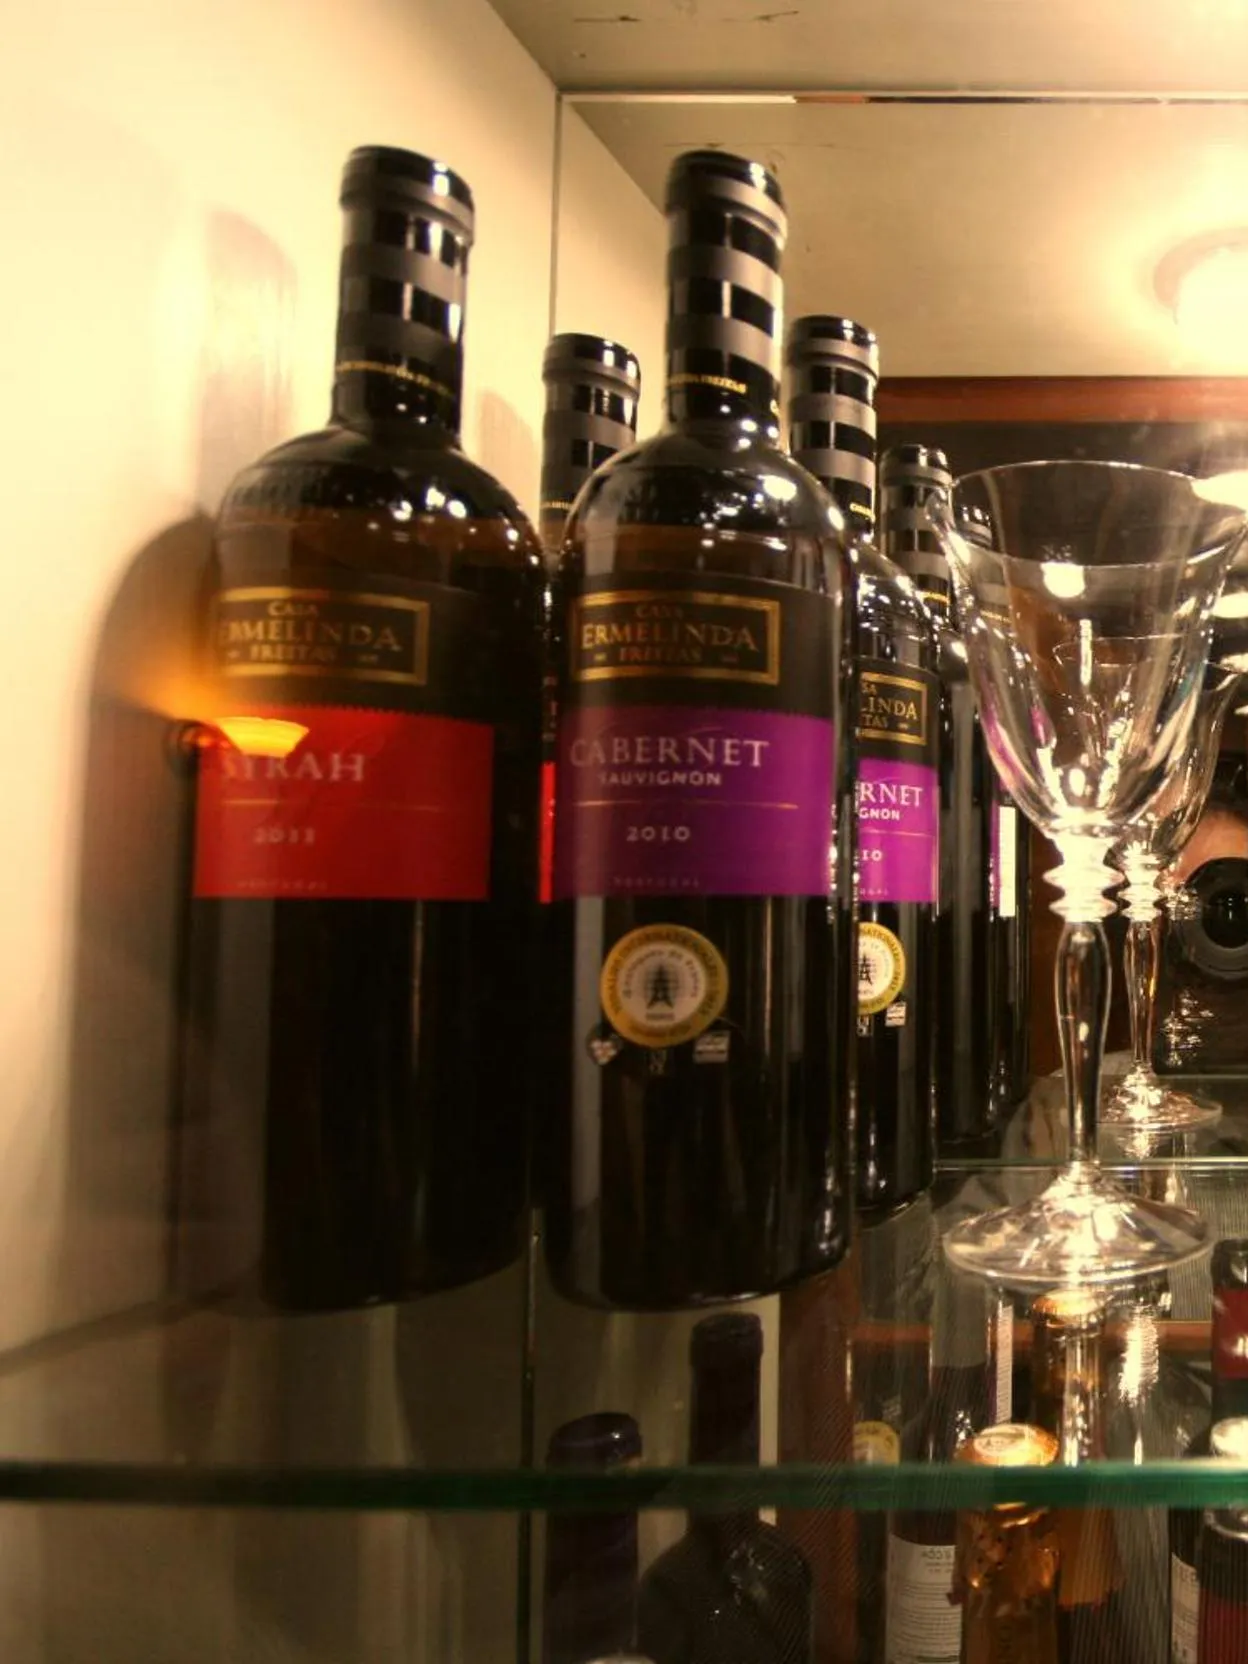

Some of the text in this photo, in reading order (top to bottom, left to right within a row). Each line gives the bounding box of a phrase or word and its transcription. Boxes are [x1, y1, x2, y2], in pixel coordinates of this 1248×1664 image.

[580, 622, 760, 653] ERMELINDA
[569, 736, 770, 768] CABERNET
[598, 770, 722, 786] SAUVIGNON
[860, 782, 923, 808] RNET
[626, 825, 691, 842] 2010
